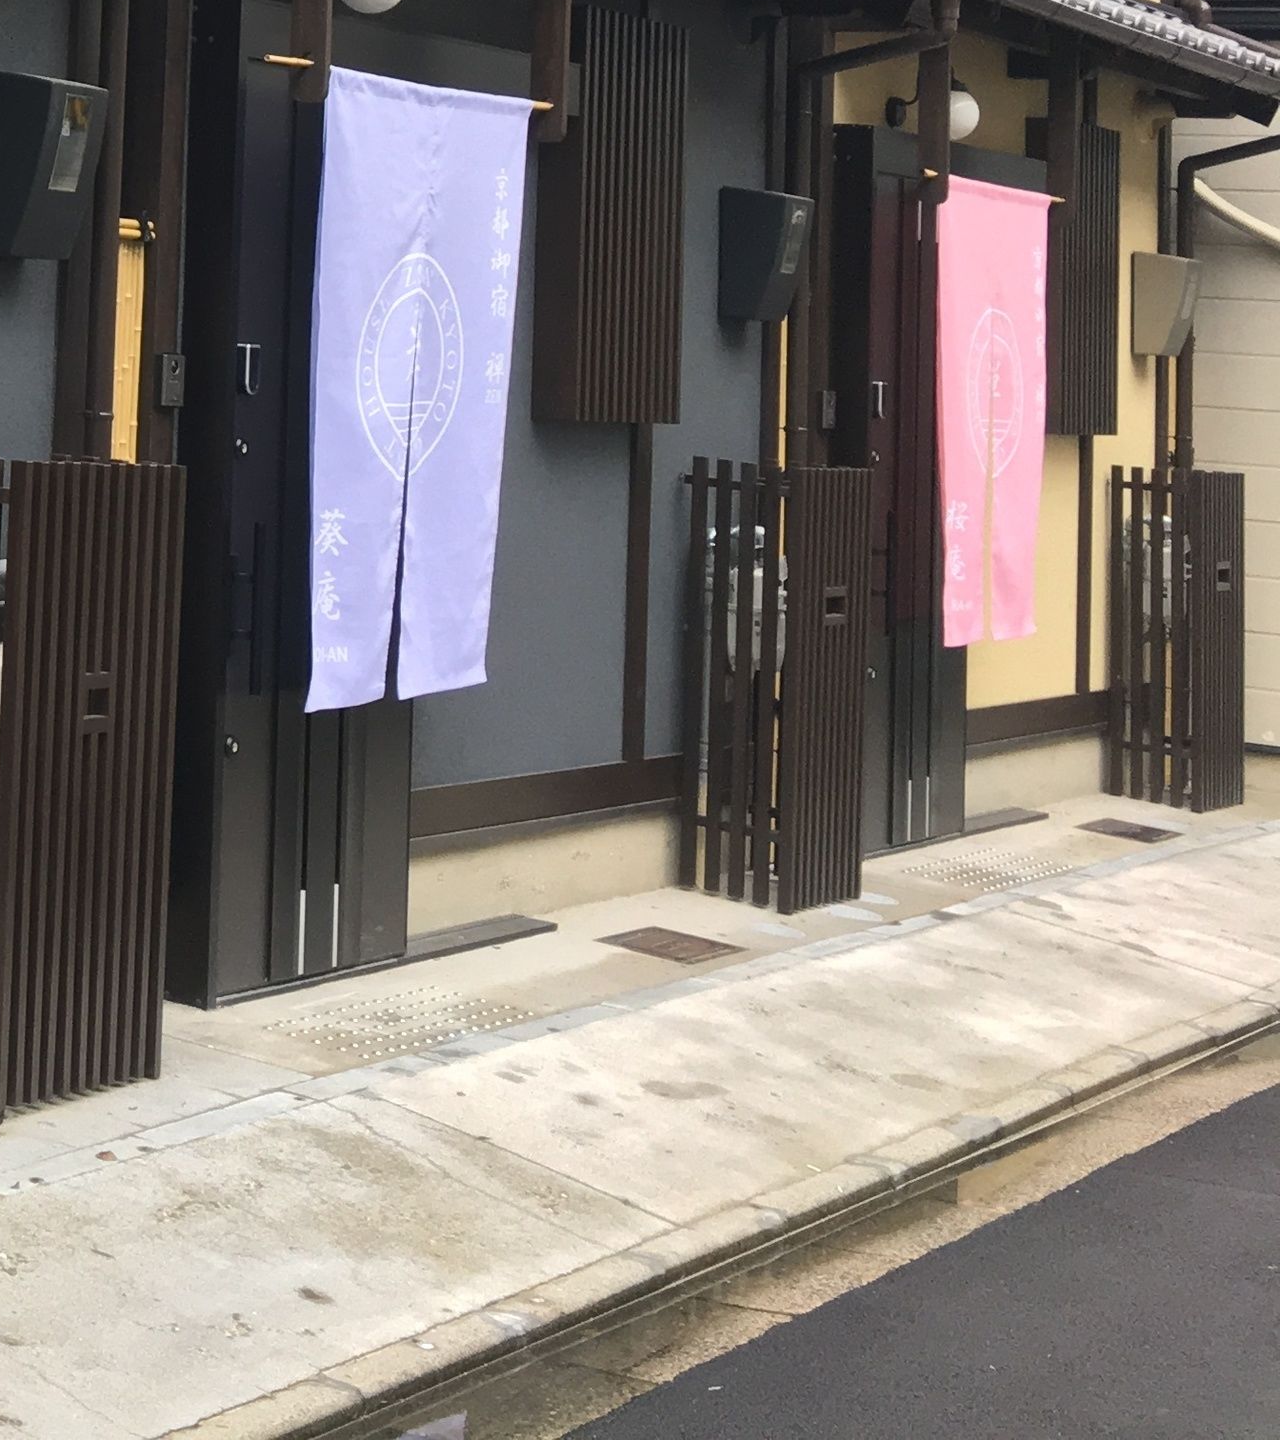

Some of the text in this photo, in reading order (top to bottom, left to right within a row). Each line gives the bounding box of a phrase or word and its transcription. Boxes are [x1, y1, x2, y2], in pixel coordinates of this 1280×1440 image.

[485, 168, 511, 385] 京都御宿 禅
[313, 509, 349, 621] 葵庵
